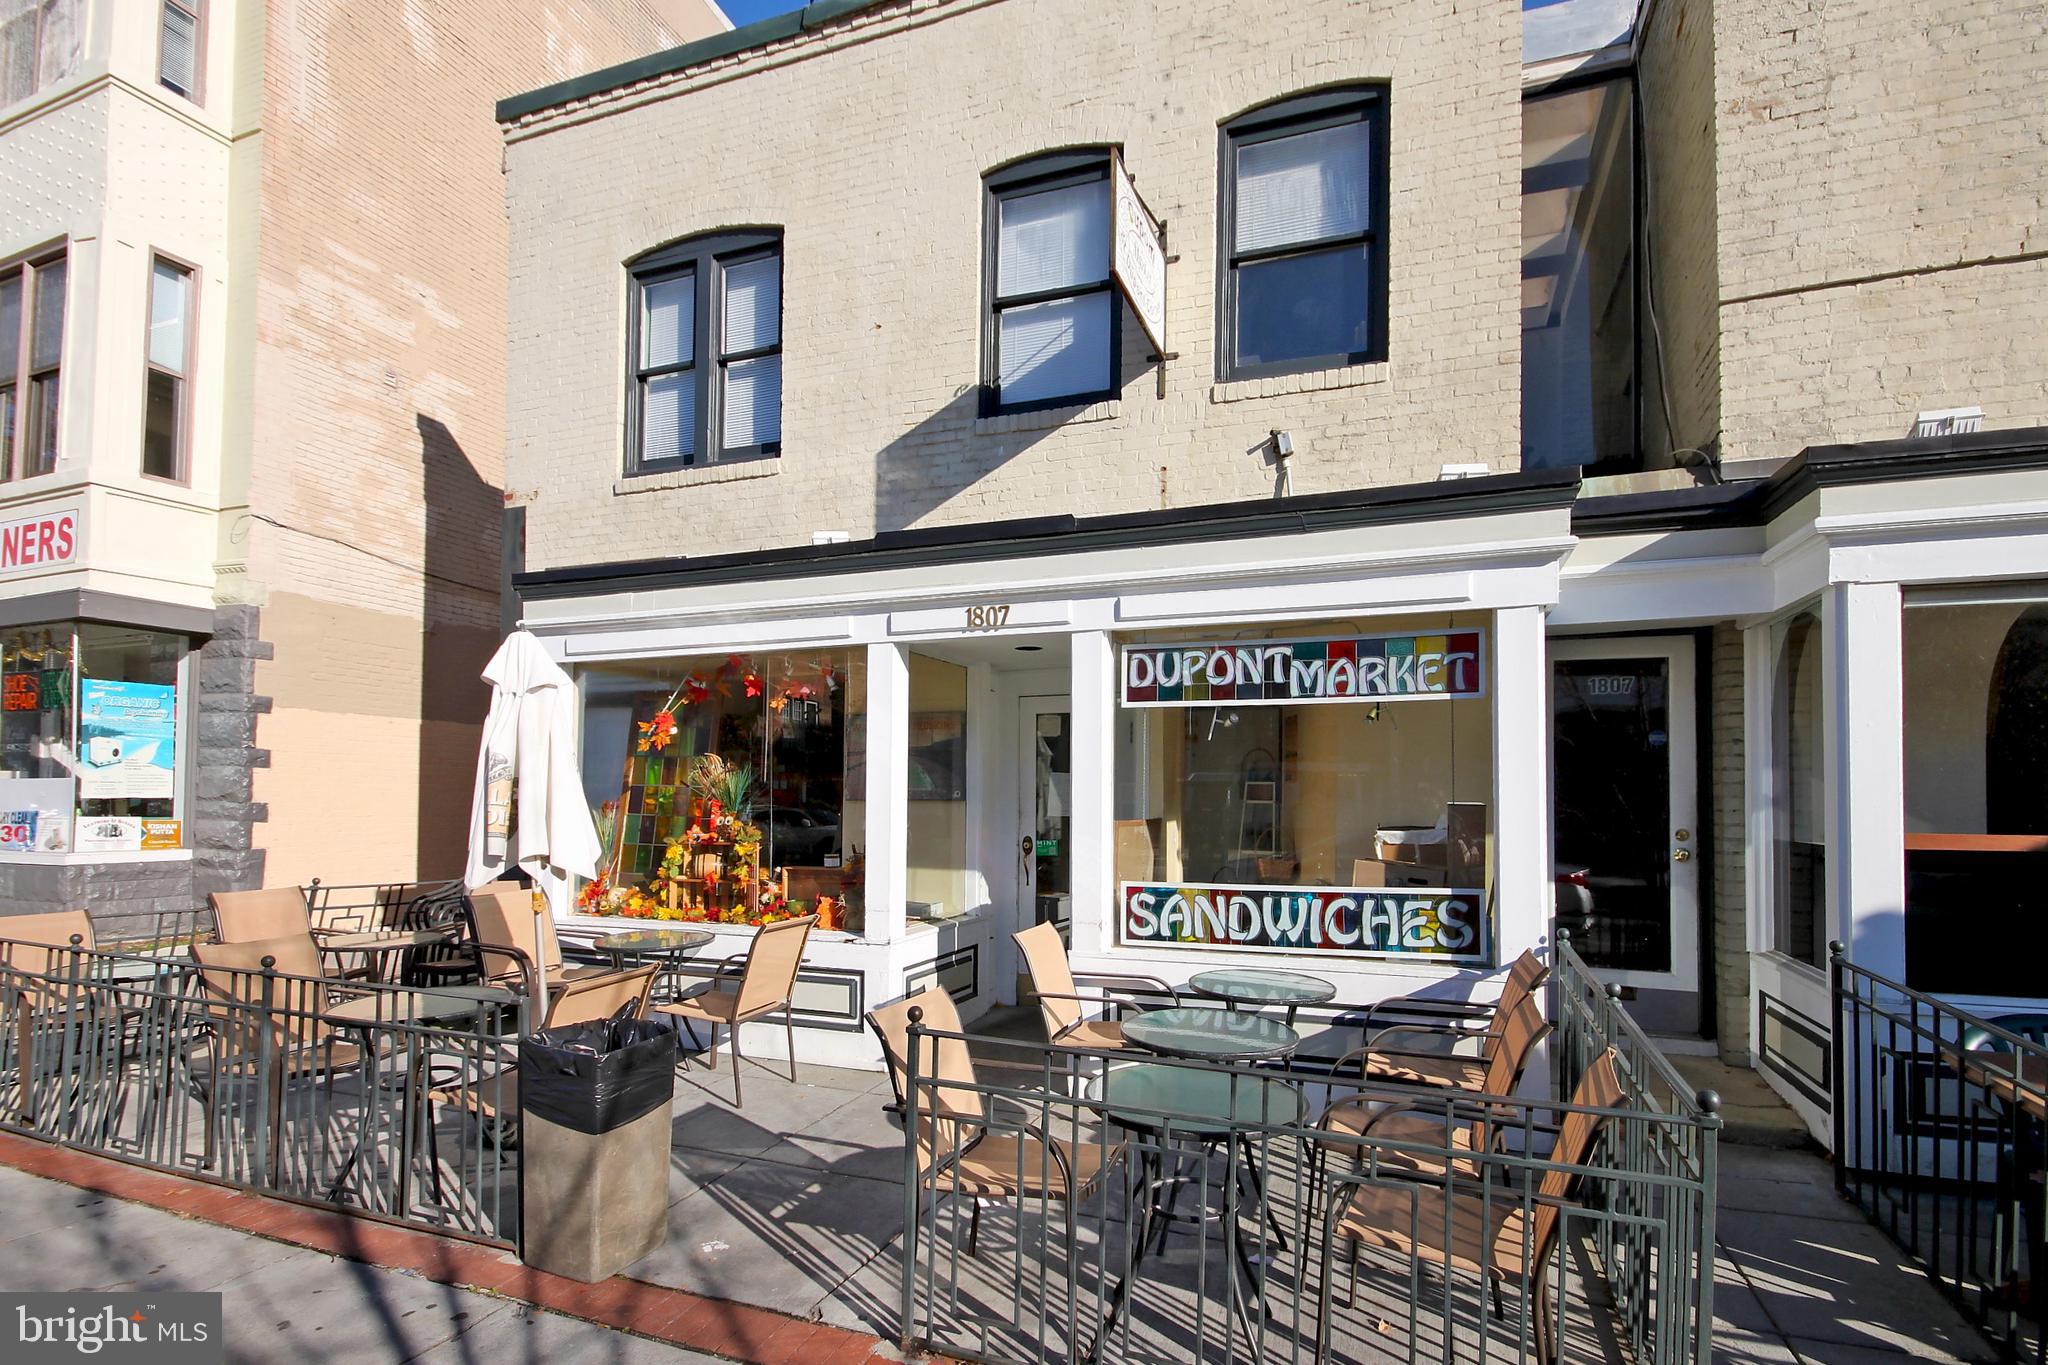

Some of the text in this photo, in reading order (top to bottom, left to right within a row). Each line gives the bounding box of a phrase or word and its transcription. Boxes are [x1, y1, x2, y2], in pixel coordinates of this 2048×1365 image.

[1, 516, 73, 568] NERS
[964, 604, 1010, 628] 1807
[1128, 645, 1474, 699] DUPONT MARKET
[1588, 675, 1635, 695] 1807
[3, 692, 37, 711] REPAIR
[102, 695, 161, 709] ORGANIC
[1128, 891, 1474, 947] SANDWICHES
